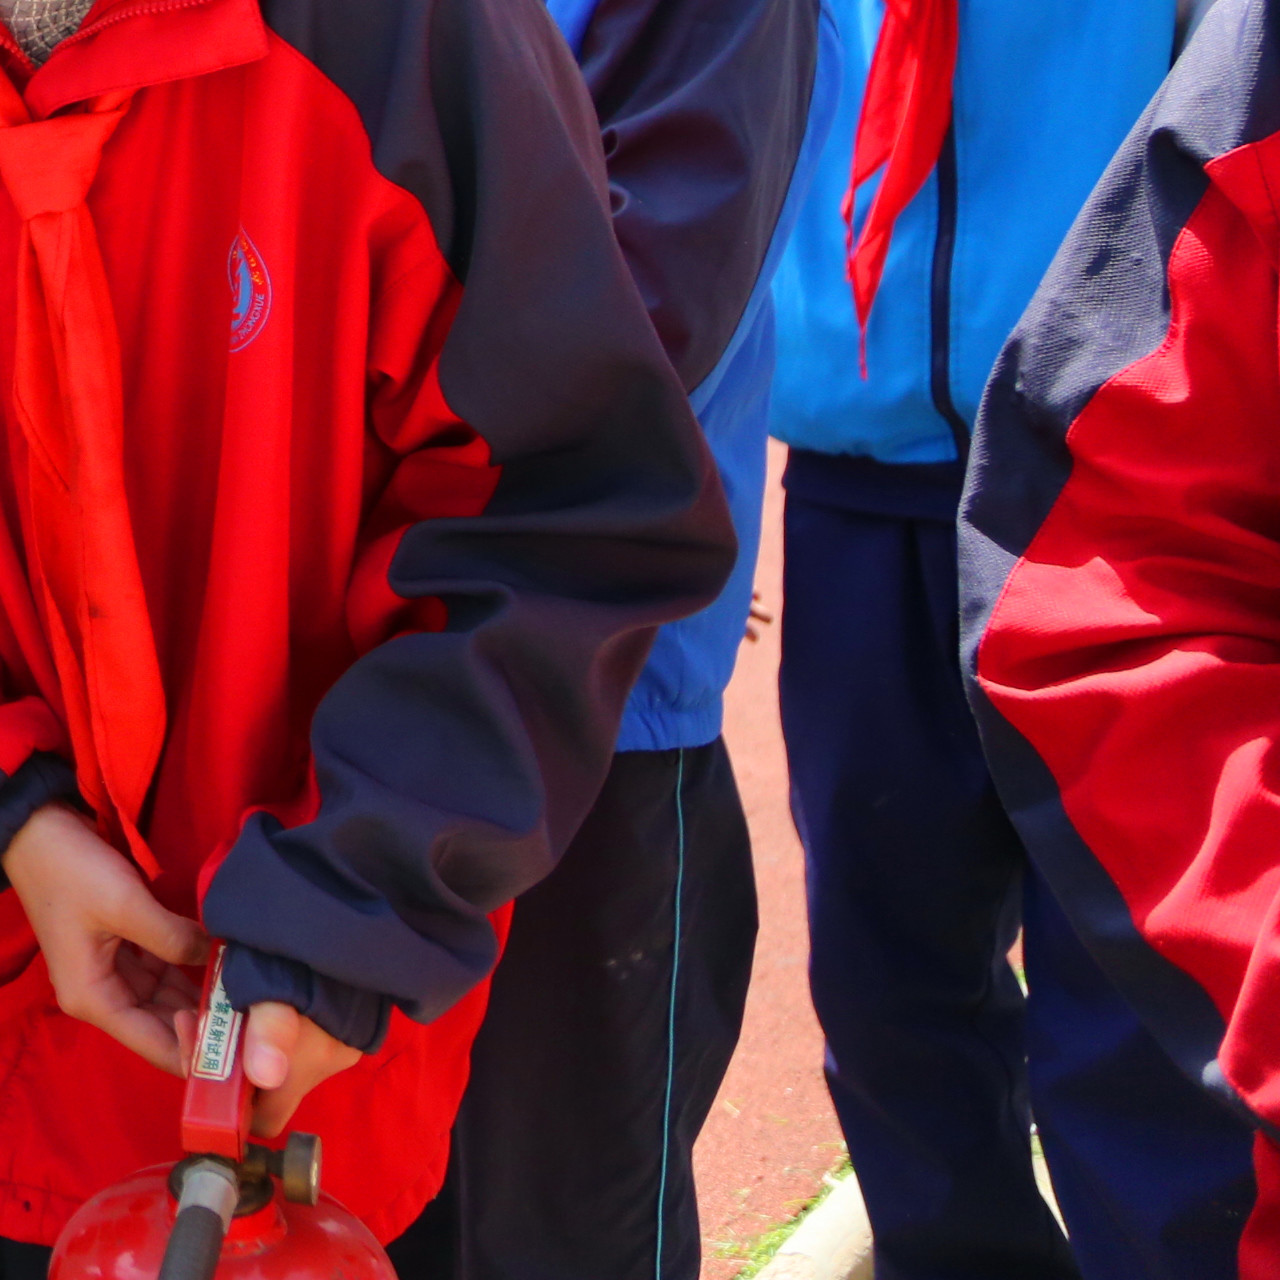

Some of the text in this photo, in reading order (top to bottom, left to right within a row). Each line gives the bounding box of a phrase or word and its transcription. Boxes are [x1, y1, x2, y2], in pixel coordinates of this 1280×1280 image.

[202, 988, 233, 1071] 禁点射试用
